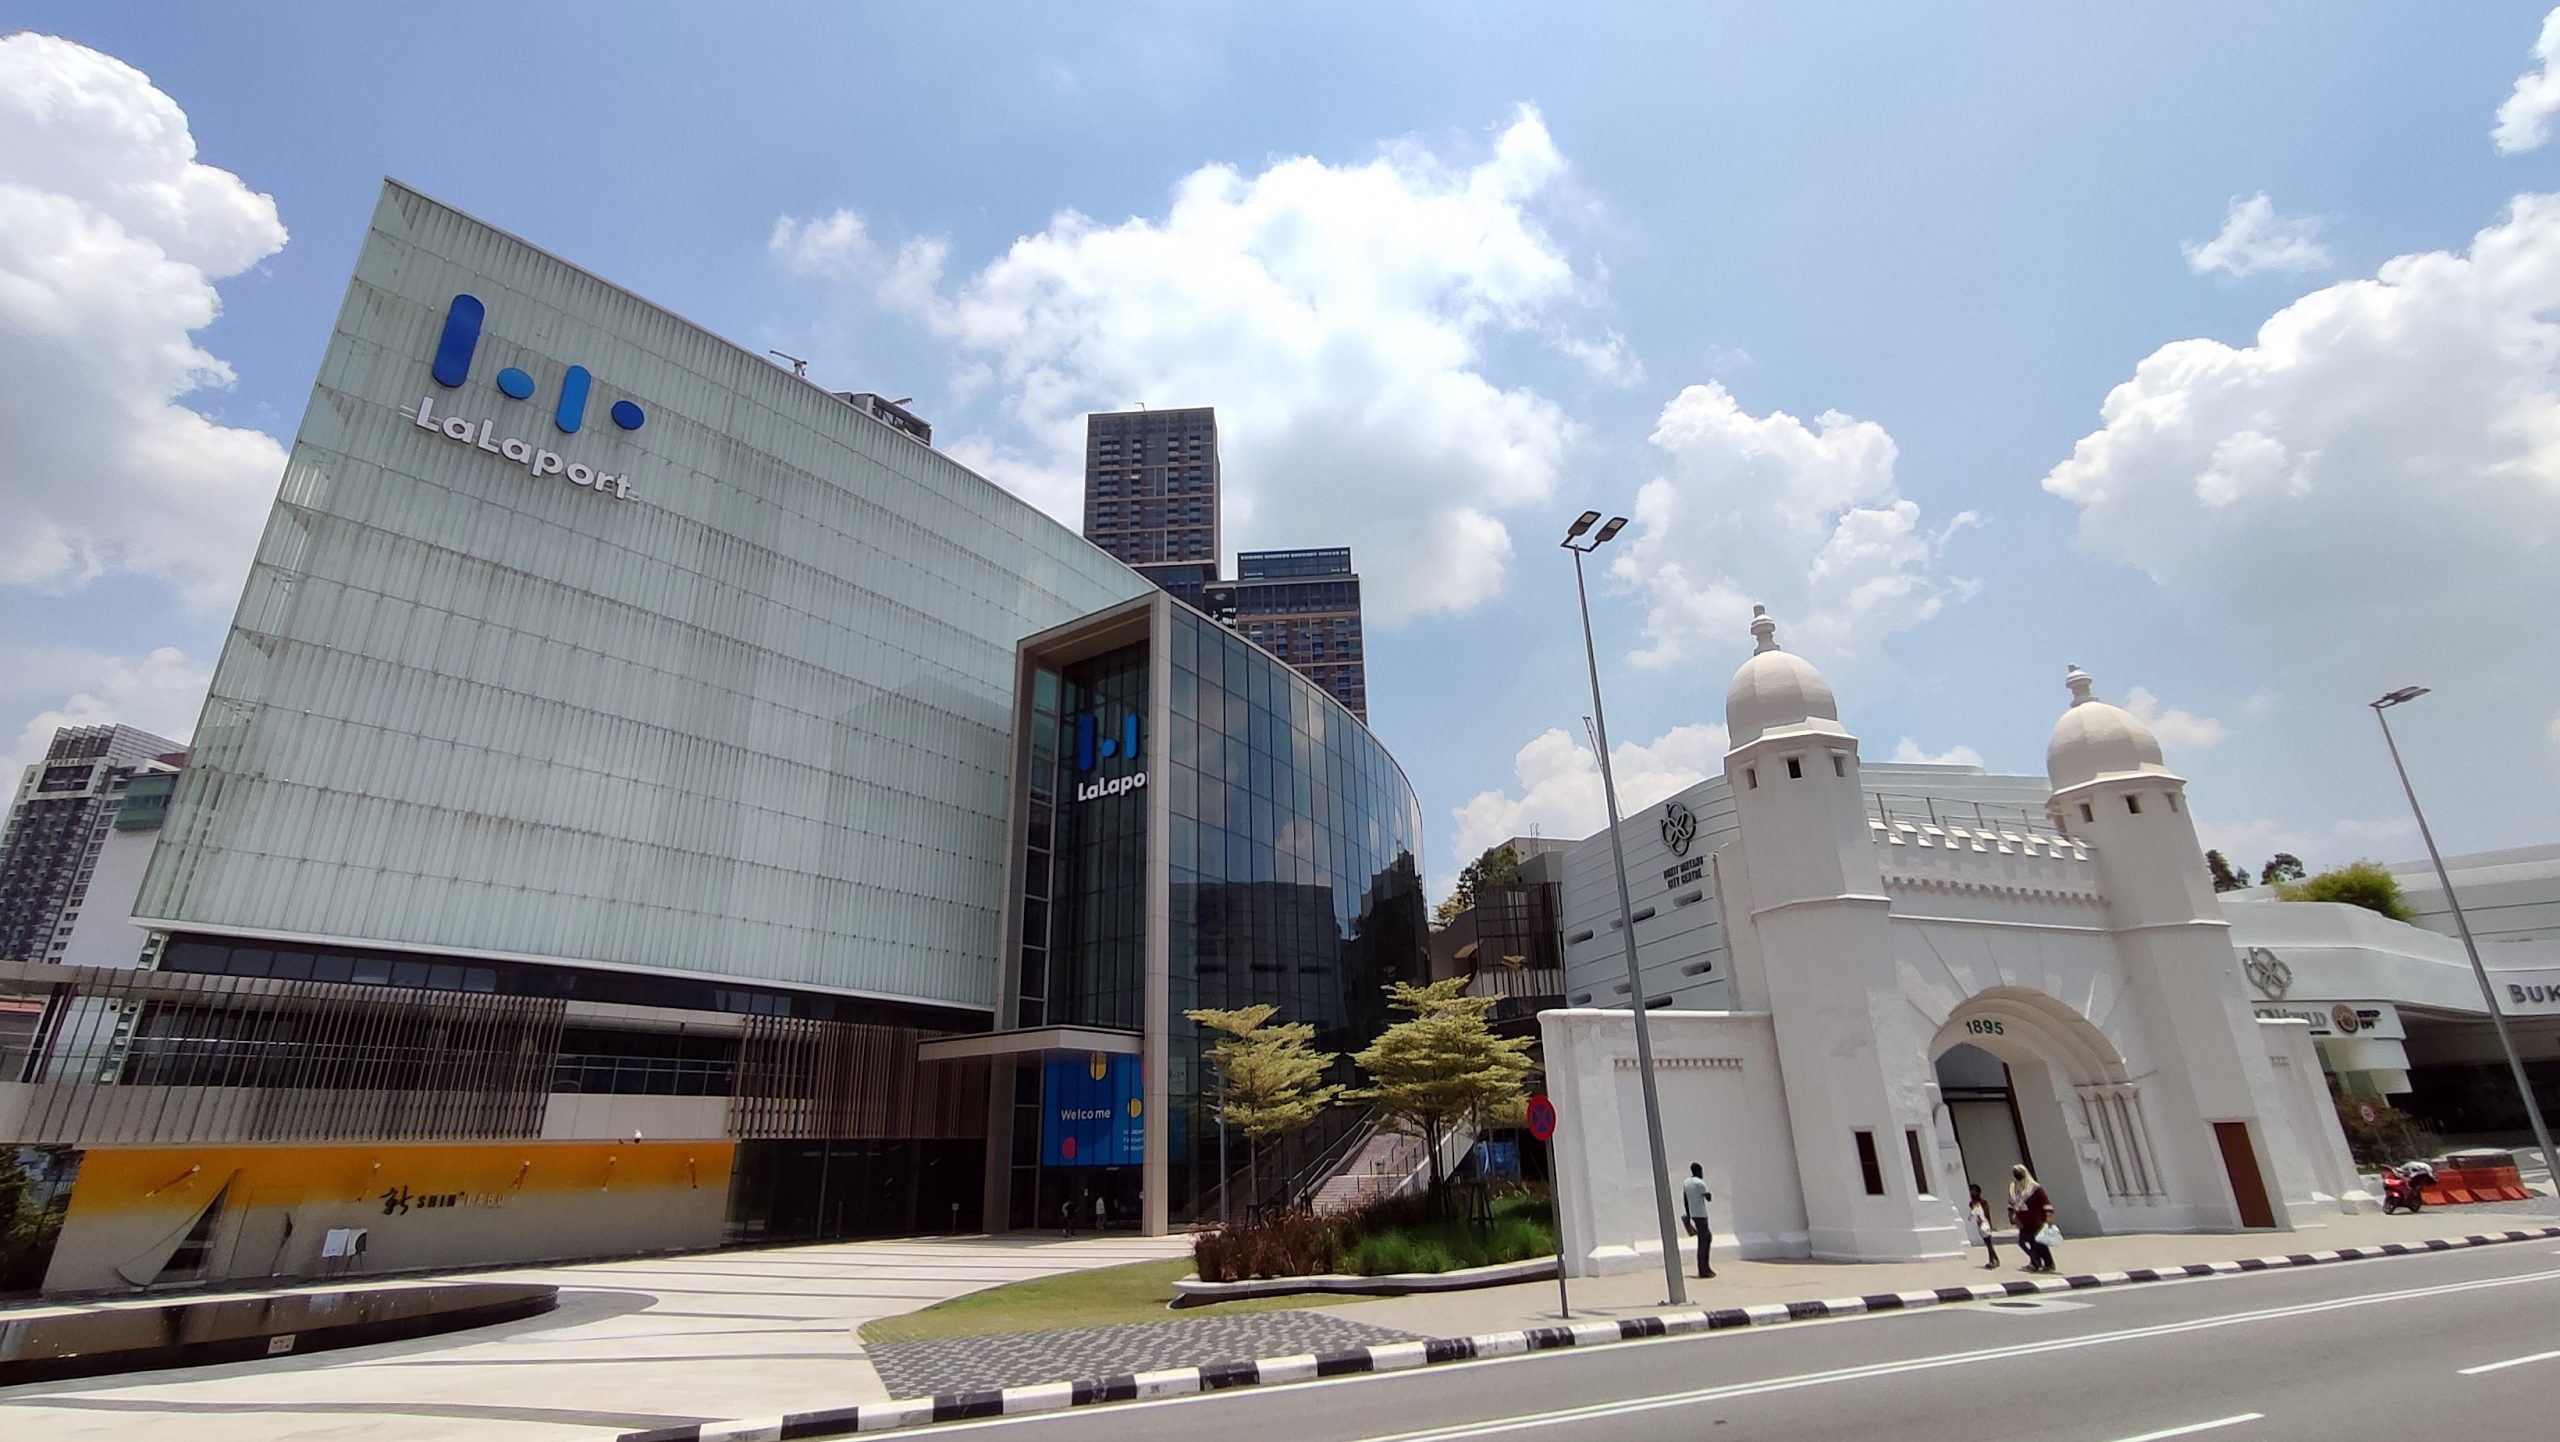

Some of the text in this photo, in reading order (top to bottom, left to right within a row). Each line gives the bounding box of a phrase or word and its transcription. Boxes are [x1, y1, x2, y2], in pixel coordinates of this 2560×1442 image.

[415, 397, 632, 500] LaLaport
[1077, 771, 1149, 802] LaLapo
[1966, 1019, 2004, 1036] 1895
[1061, 1108, 1111, 1121] Welcome
